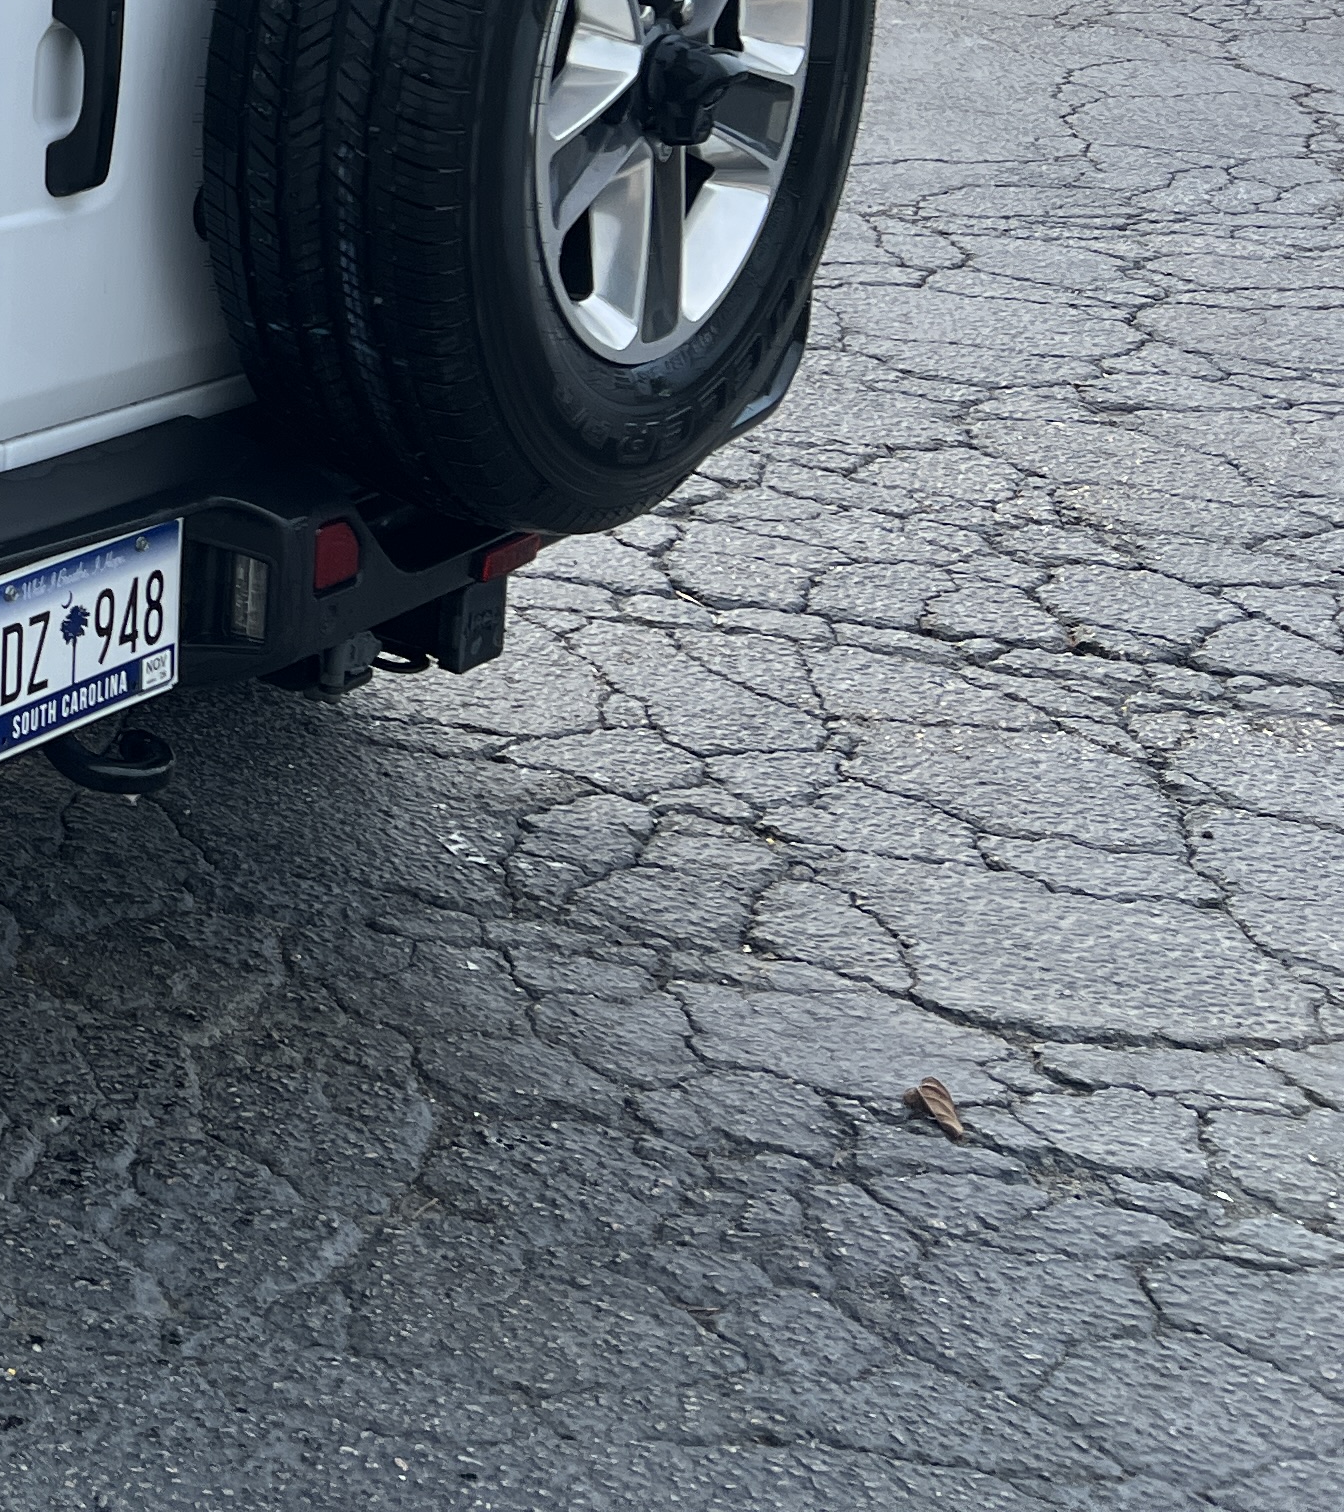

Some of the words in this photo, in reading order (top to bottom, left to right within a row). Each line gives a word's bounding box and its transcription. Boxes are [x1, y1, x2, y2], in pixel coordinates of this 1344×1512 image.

[94, 569, 164, 665] 948
[146, 652, 167, 675] NOV
[12, 699, 57, 739] SOUTH
[61, 670, 128, 718] CAROLINA
